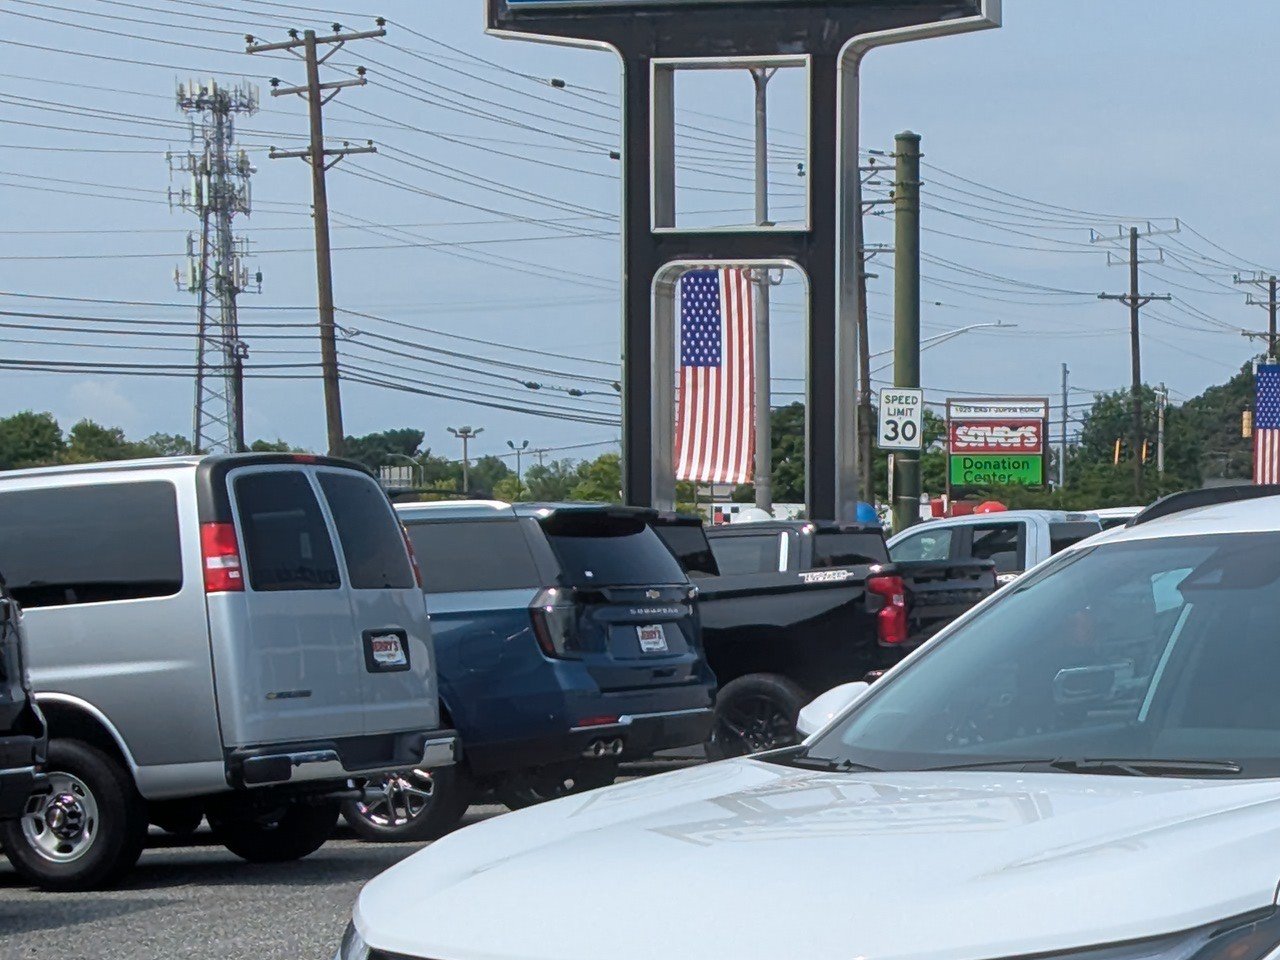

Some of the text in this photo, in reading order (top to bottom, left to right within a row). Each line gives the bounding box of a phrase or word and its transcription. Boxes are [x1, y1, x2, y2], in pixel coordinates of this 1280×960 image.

[884, 394, 919, 406] SPEED
[887, 407, 914, 417] LIMIT
[883, 419, 918, 442] 30
[962, 457, 1030, 470] Donation
[963, 470, 1013, 483] Center
